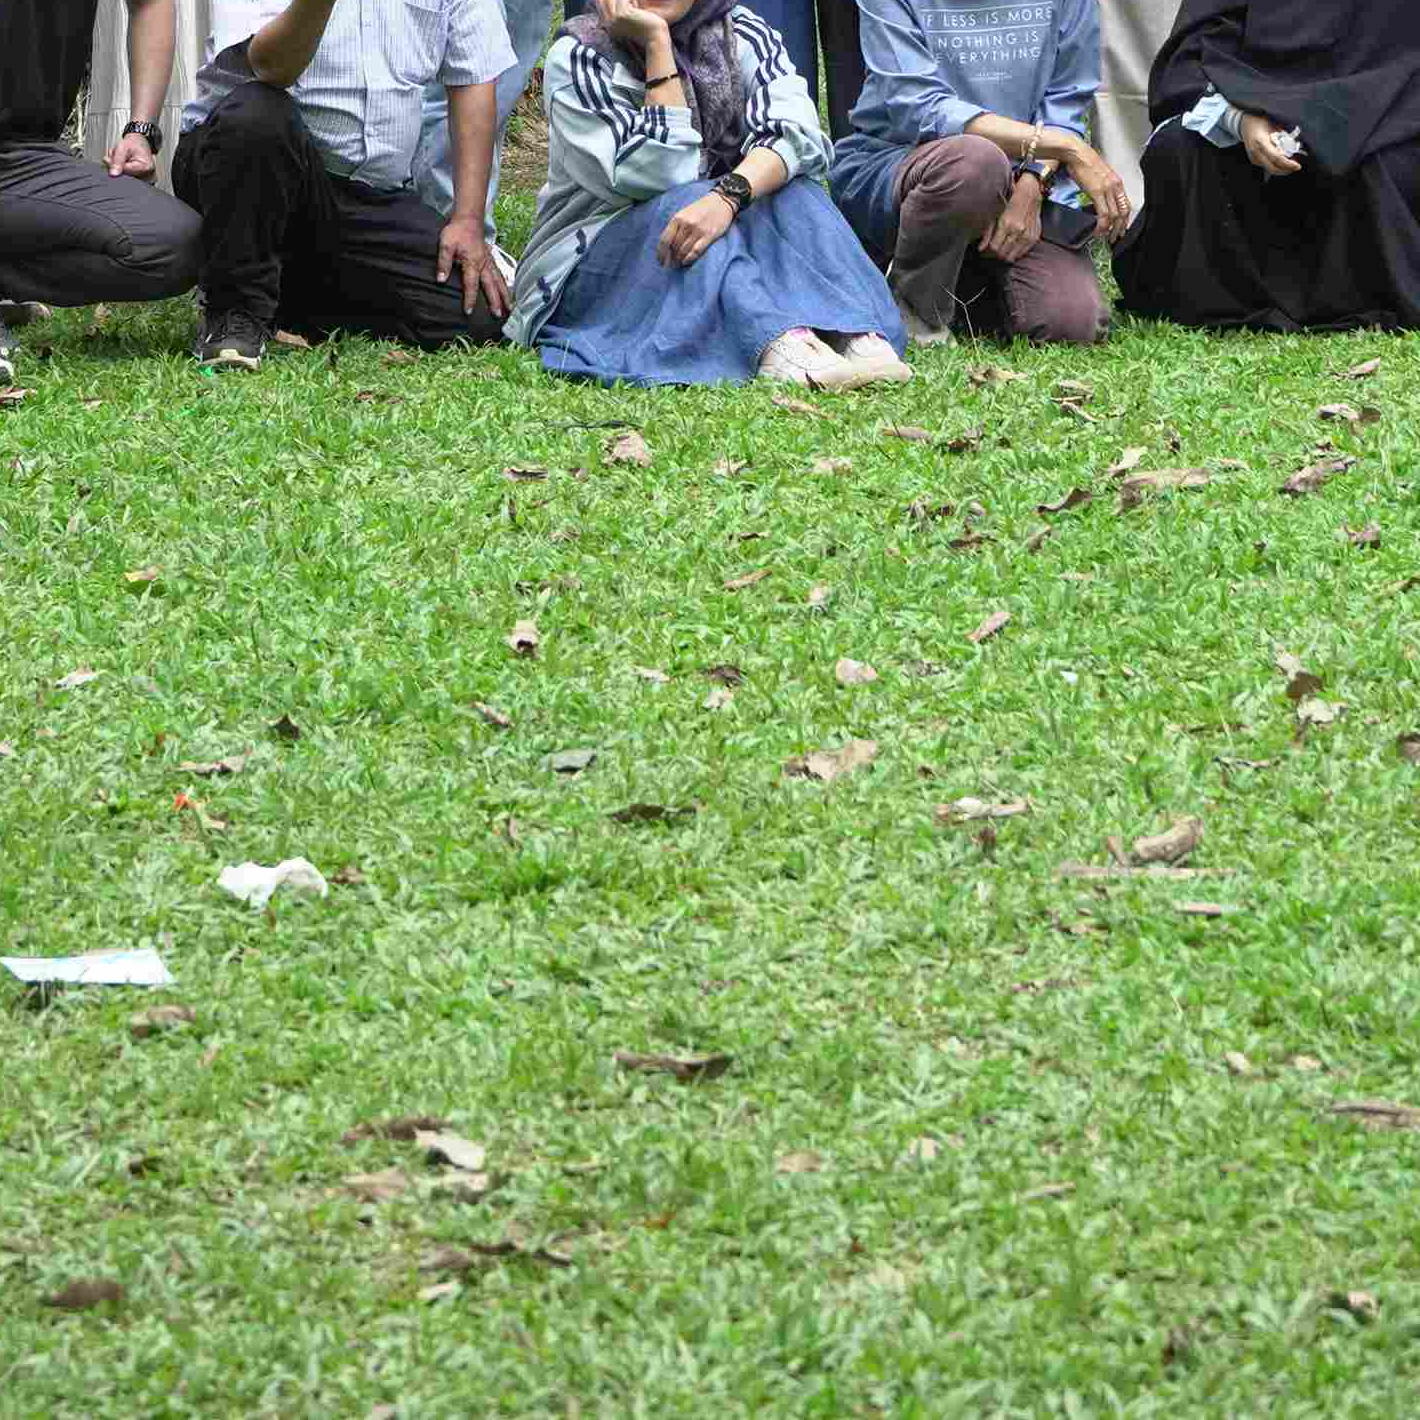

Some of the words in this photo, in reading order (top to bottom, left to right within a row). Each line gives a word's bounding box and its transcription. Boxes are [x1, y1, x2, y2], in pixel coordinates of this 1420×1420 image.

[942, 11, 977, 28] LESS
[985, 11, 999, 25] IS
[937, 31, 1018, 49] NOTHING
[1026, 29, 1039, 43] IS
[934, 46, 1041, 65] EVERYTHING
